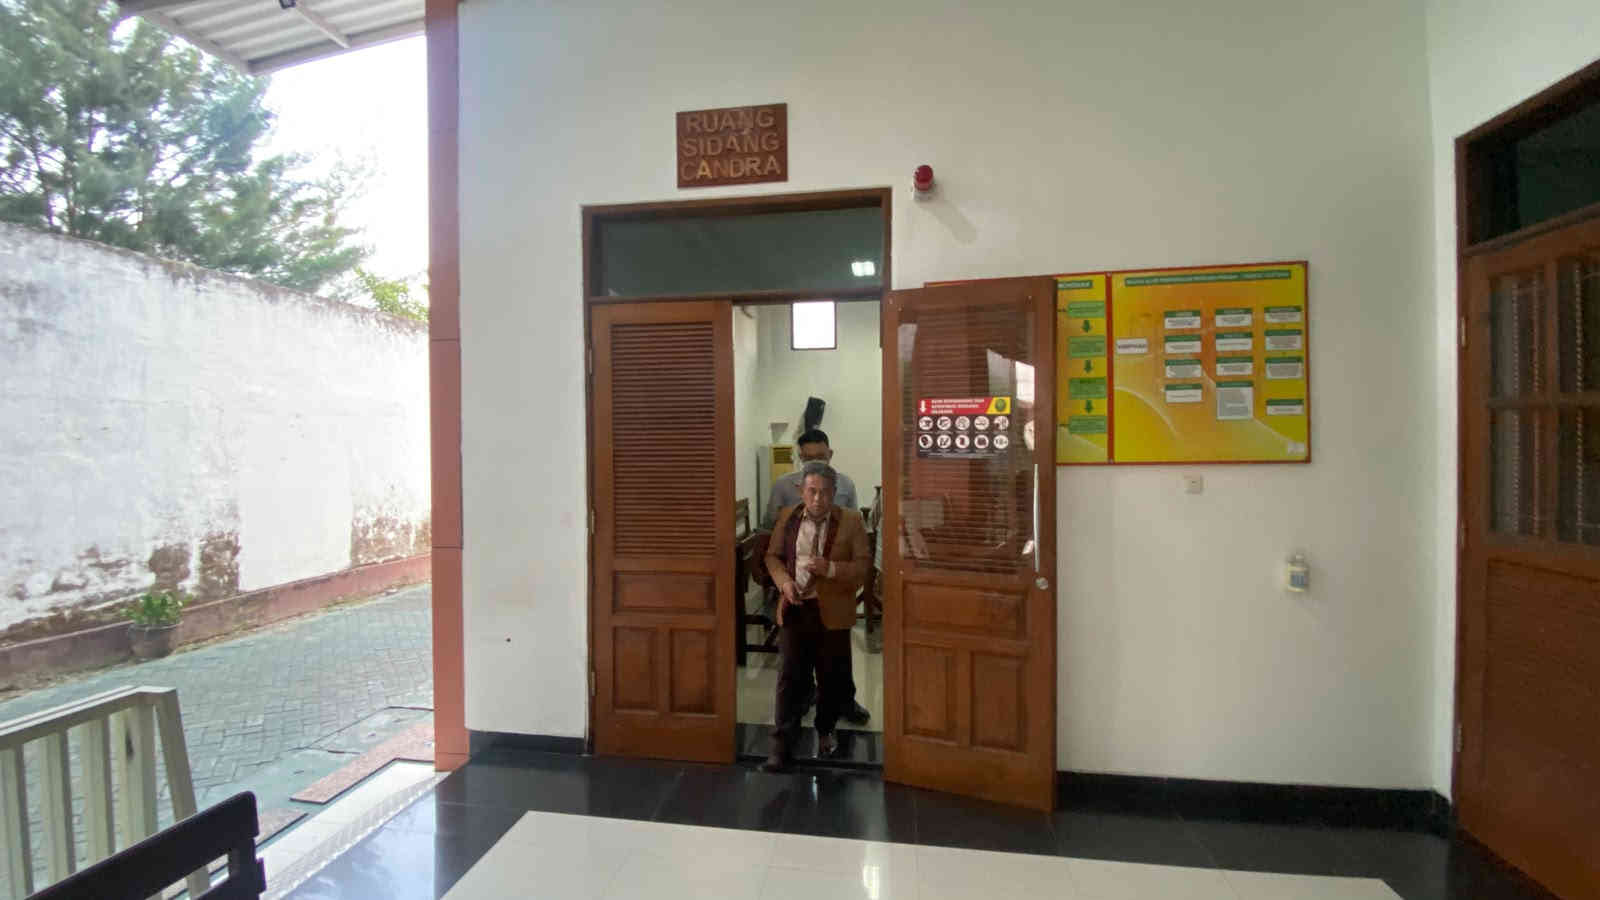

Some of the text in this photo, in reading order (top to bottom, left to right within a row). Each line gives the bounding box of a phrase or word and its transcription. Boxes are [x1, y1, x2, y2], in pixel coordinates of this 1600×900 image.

[686, 110, 775, 133] RUANG
[680, 132, 780, 157] SIDANG
[681, 155, 781, 180] CANDRA
